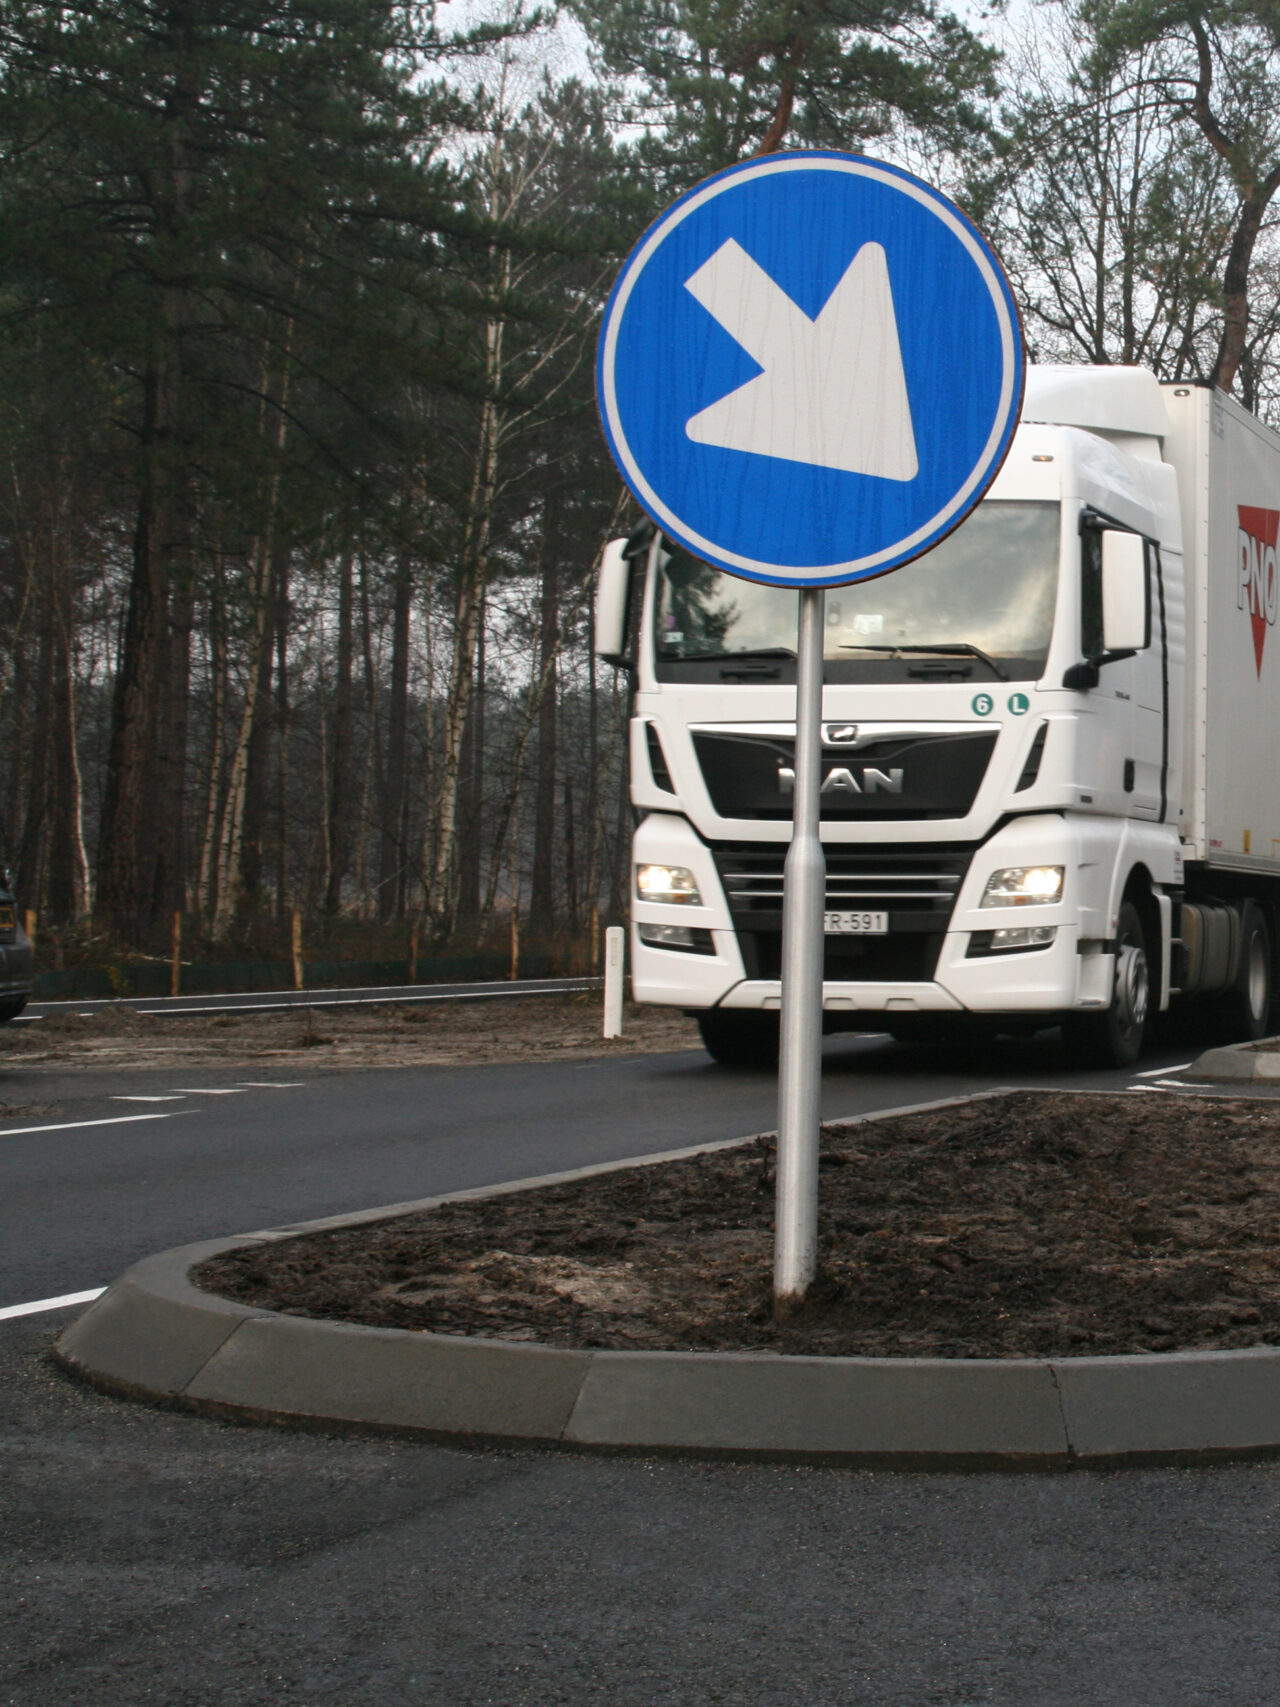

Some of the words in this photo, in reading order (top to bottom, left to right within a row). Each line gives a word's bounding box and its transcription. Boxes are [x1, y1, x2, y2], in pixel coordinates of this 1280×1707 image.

[1237, 525, 1278, 626] PNO
[976, 697, 989, 713] 6
[1012, 696, 1026, 713] L
